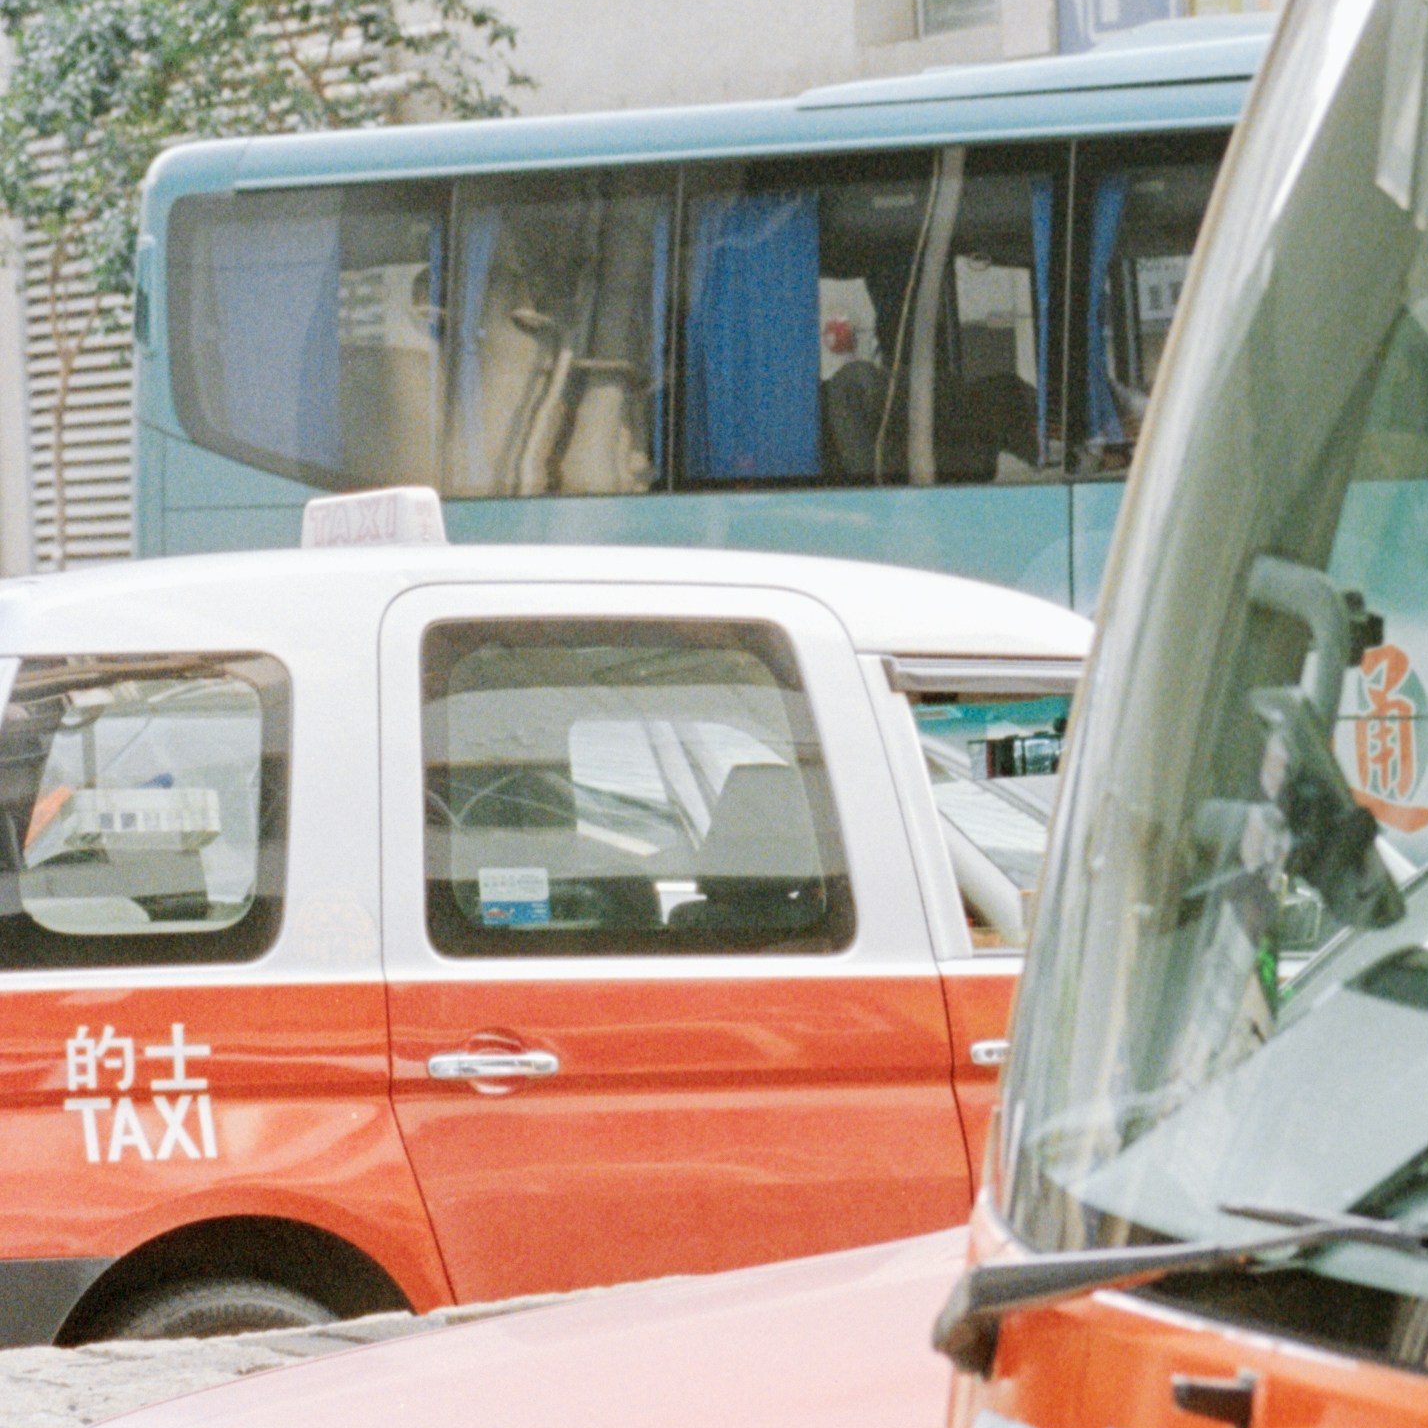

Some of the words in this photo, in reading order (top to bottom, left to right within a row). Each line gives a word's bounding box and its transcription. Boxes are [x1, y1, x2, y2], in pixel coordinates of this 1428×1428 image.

[309, 494, 397, 547] TAXI
[66, 1022, 212, 1092] 的士
[63, 1094, 218, 1163] TAXI
